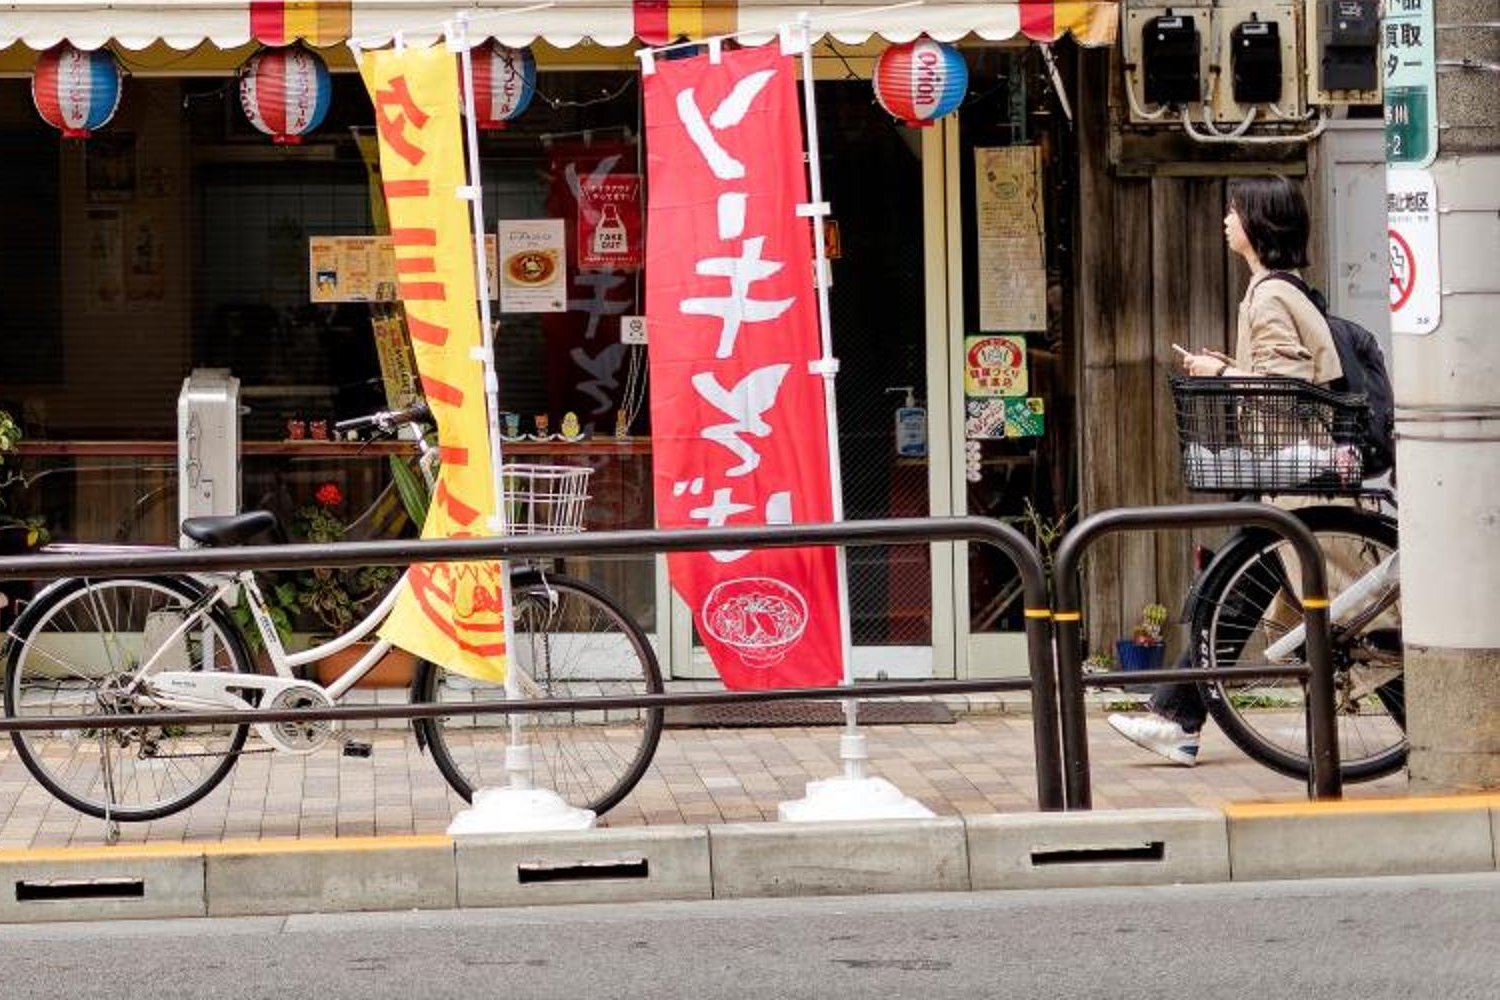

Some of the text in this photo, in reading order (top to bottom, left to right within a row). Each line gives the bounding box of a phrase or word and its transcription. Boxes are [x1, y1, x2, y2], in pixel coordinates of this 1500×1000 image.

[916, 51, 942, 105] Orion
[599, 233, 623, 241] TAKE
[601, 241, 621, 249] OUT
[1201, 629, 1221, 699] KNDA
